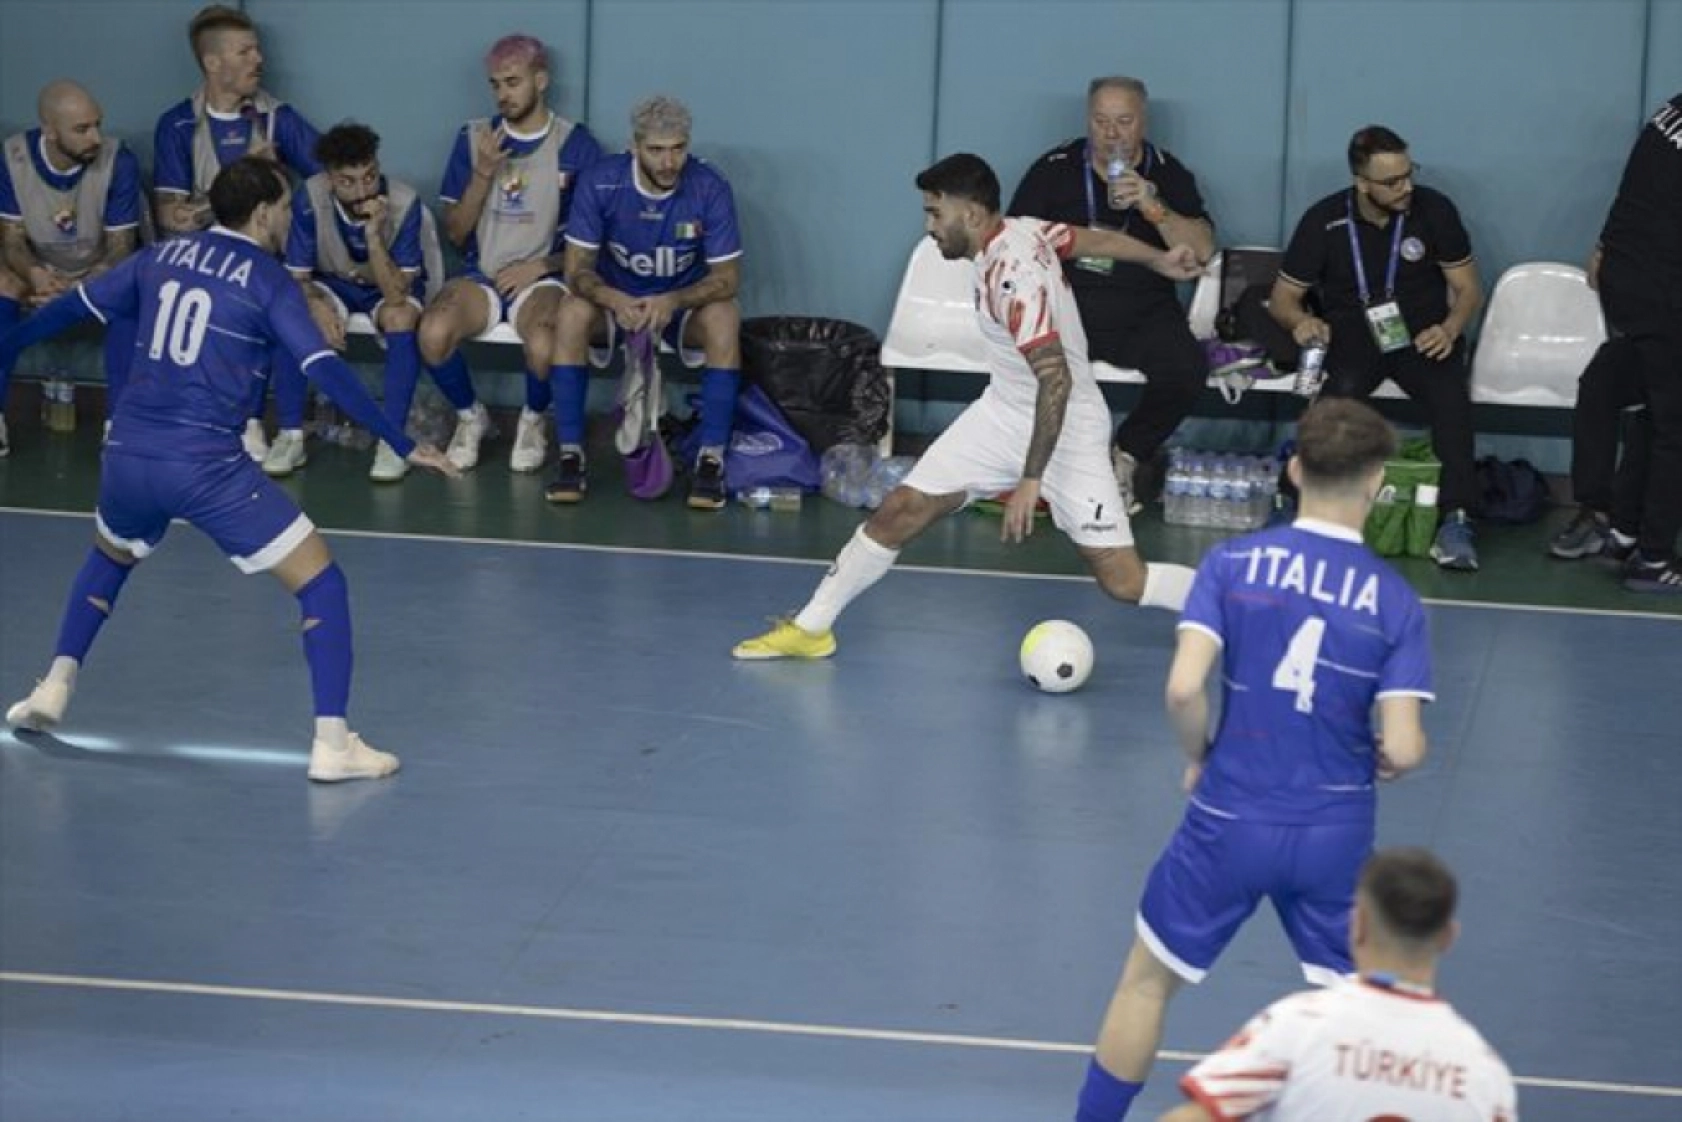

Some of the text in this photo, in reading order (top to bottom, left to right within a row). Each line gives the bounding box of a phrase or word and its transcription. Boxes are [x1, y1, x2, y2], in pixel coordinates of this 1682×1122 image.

[156, 239, 252, 288] ITALIA
[149, 279, 212, 366] 10
[1246, 546, 1379, 616] ITALIA
[1271, 616, 1327, 713] 4
